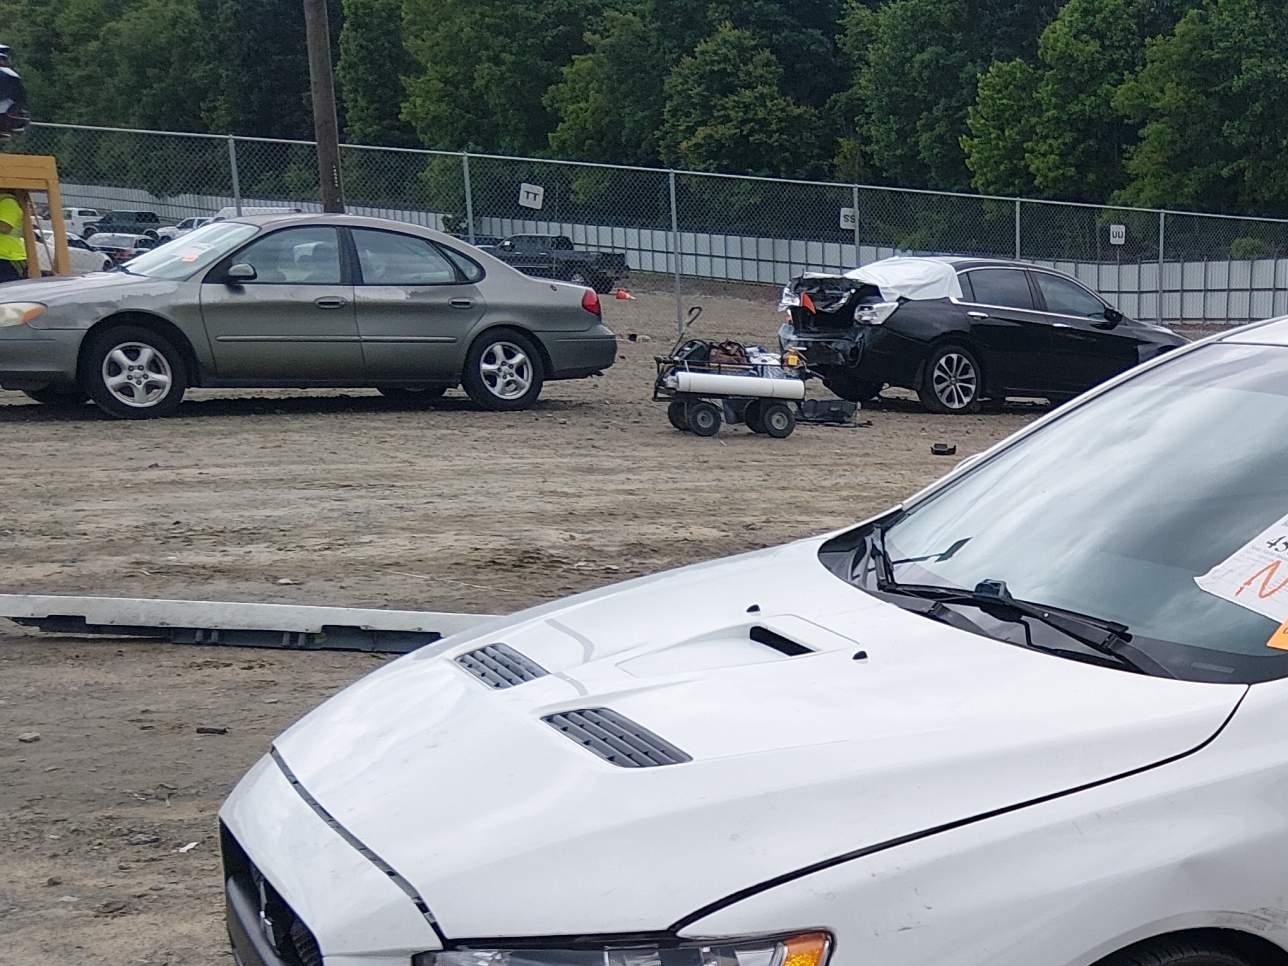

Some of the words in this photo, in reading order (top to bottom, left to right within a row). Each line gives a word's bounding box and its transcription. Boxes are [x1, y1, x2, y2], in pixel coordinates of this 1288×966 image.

[523, 190, 541, 201] TT
[843, 214, 856, 224] SS
[1112, 230, 1124, 239] UU
